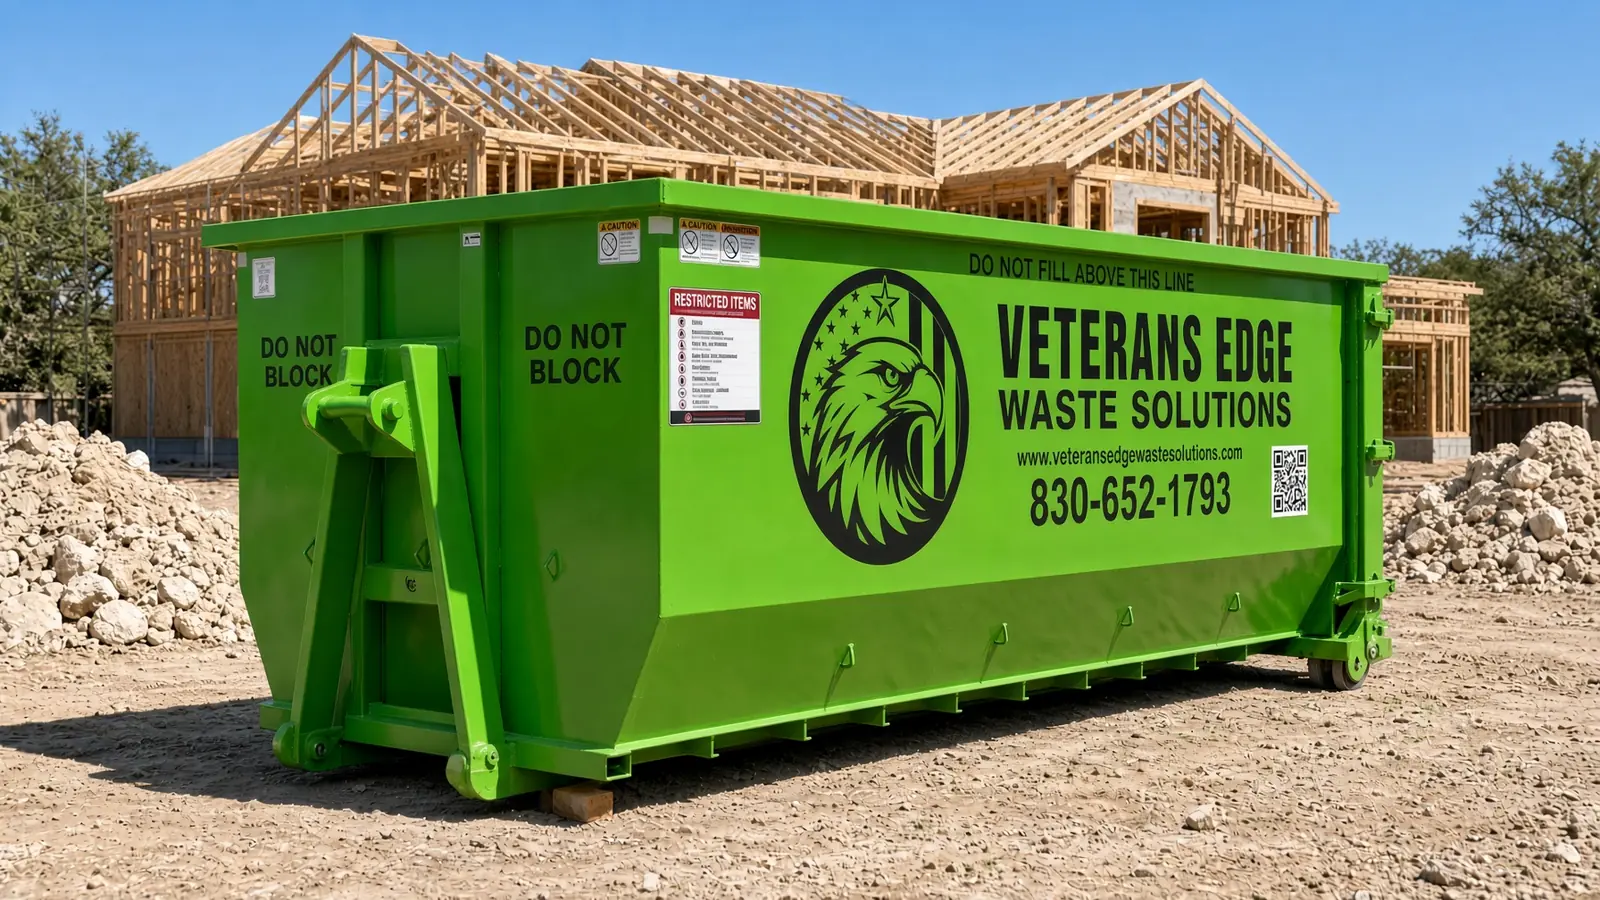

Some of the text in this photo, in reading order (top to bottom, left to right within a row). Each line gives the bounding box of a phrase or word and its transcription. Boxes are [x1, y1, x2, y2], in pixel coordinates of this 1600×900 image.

[606, 220, 638, 231] CAUTION
[687, 220, 718, 231] CAUTION
[969, 252, 1195, 292] DO NOT FILL ABOVE THIS LINE
[674, 292, 757, 311] RESTRICTED ITEMS
[261, 334, 337, 359] DO NOT
[524, 322, 627, 351] DO NOT
[997, 303, 1293, 383] VETERANS EDGE
[265, 364, 333, 388] BLOCK
[528, 357, 622, 385] BLOCK
[998, 389, 1292, 431] WASTE SOLUTIONS
[1017, 444, 1243, 469] www.veteransedgewastesolutions.com
[1029, 471, 1231, 527] 830-652-1793
